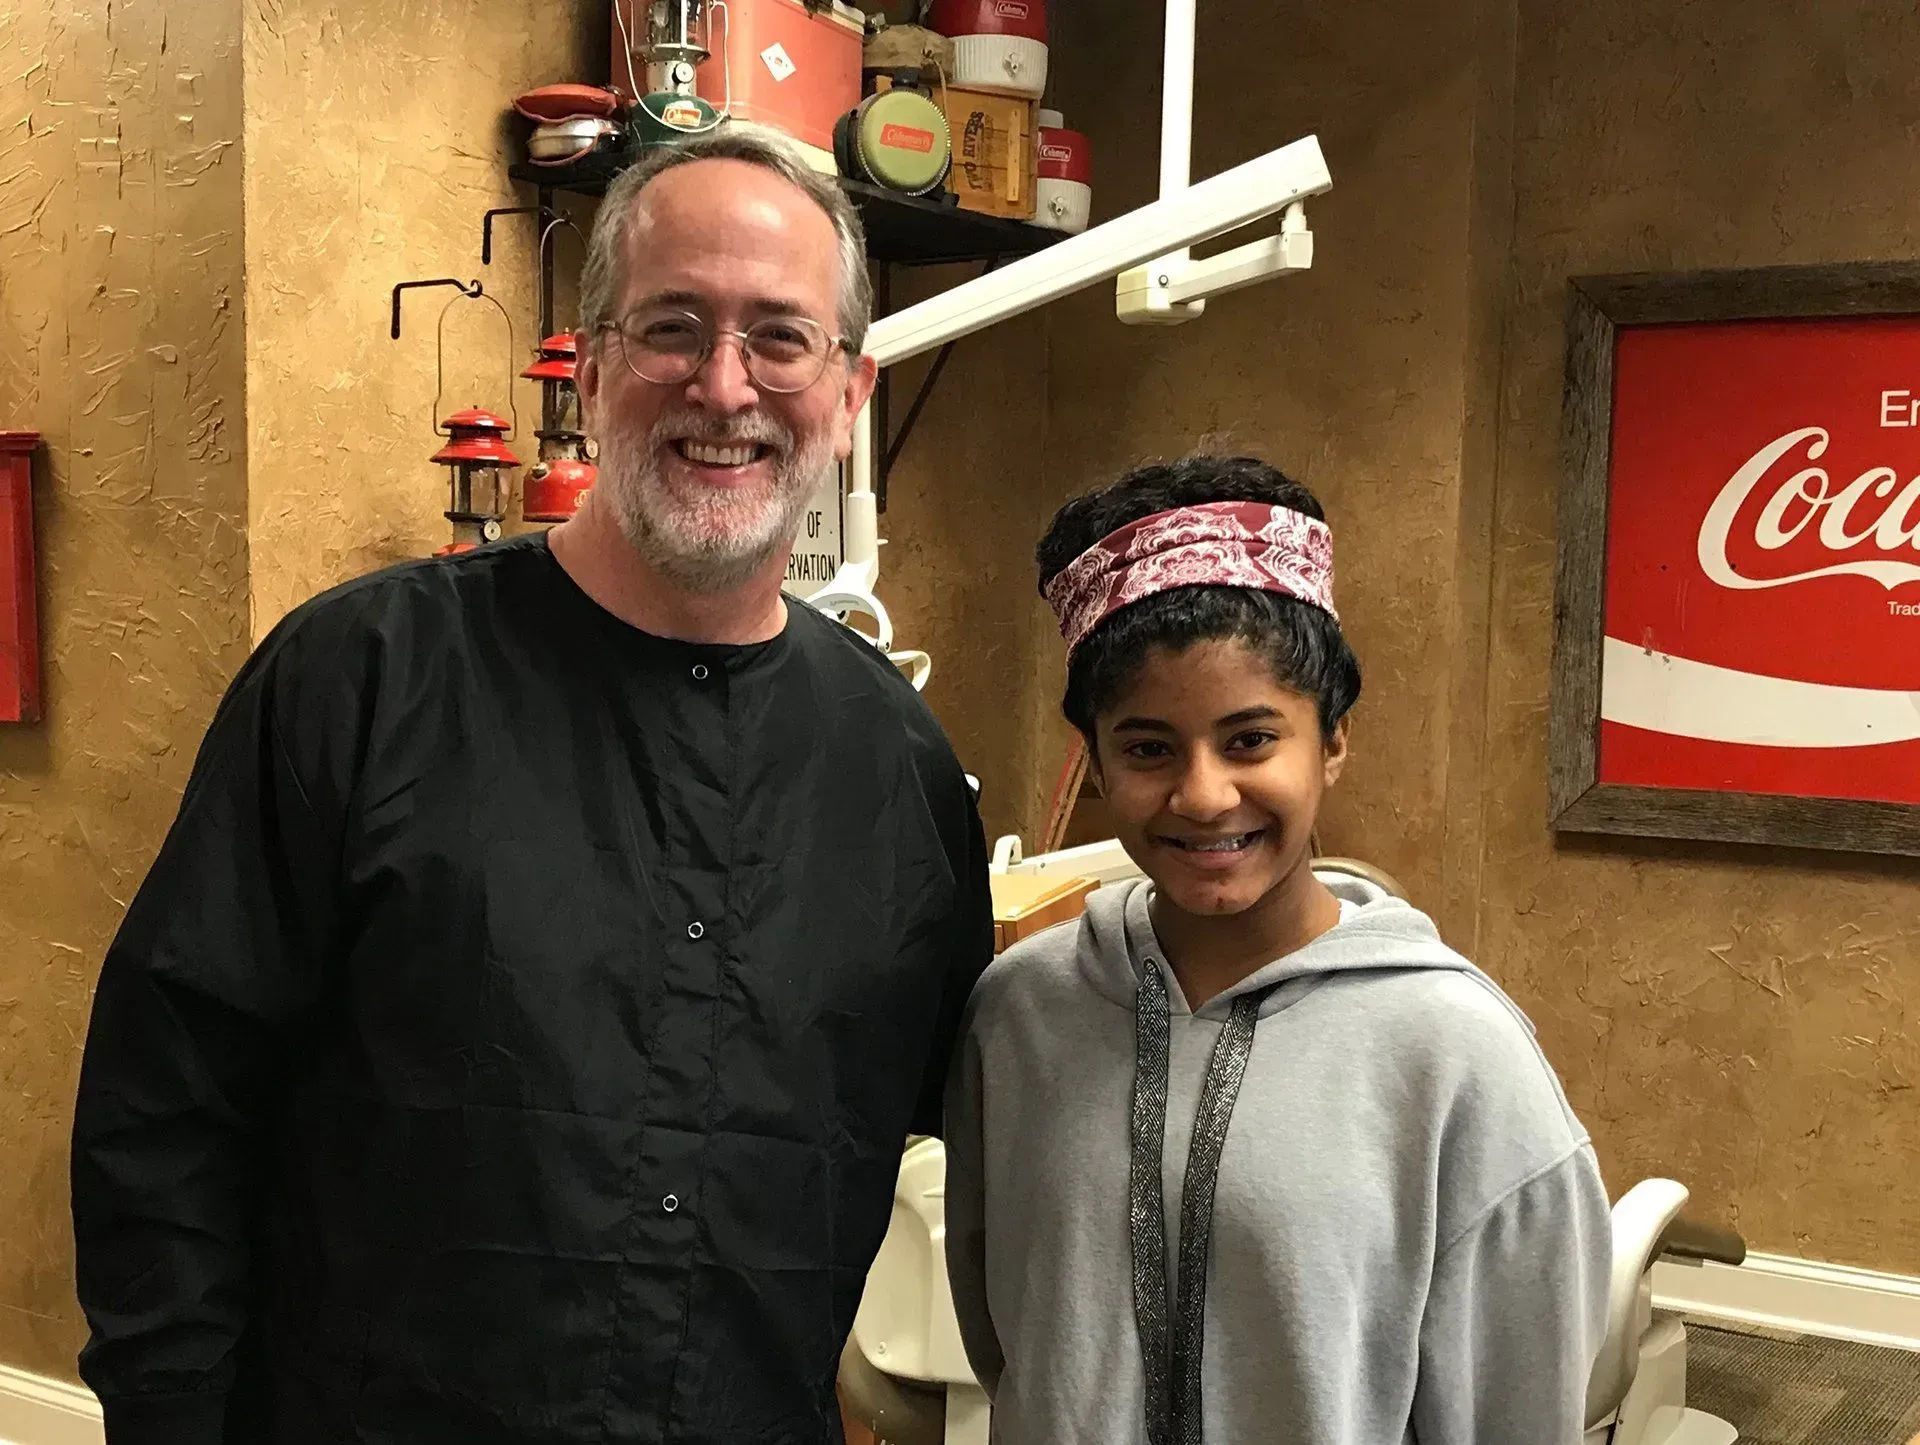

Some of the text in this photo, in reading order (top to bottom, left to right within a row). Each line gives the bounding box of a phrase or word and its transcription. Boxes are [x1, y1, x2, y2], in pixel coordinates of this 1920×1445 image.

[963, 111, 984, 190] TWO RIVERS
[807, 511, 822, 538] OF
[784, 554, 835, 581] RVATION
